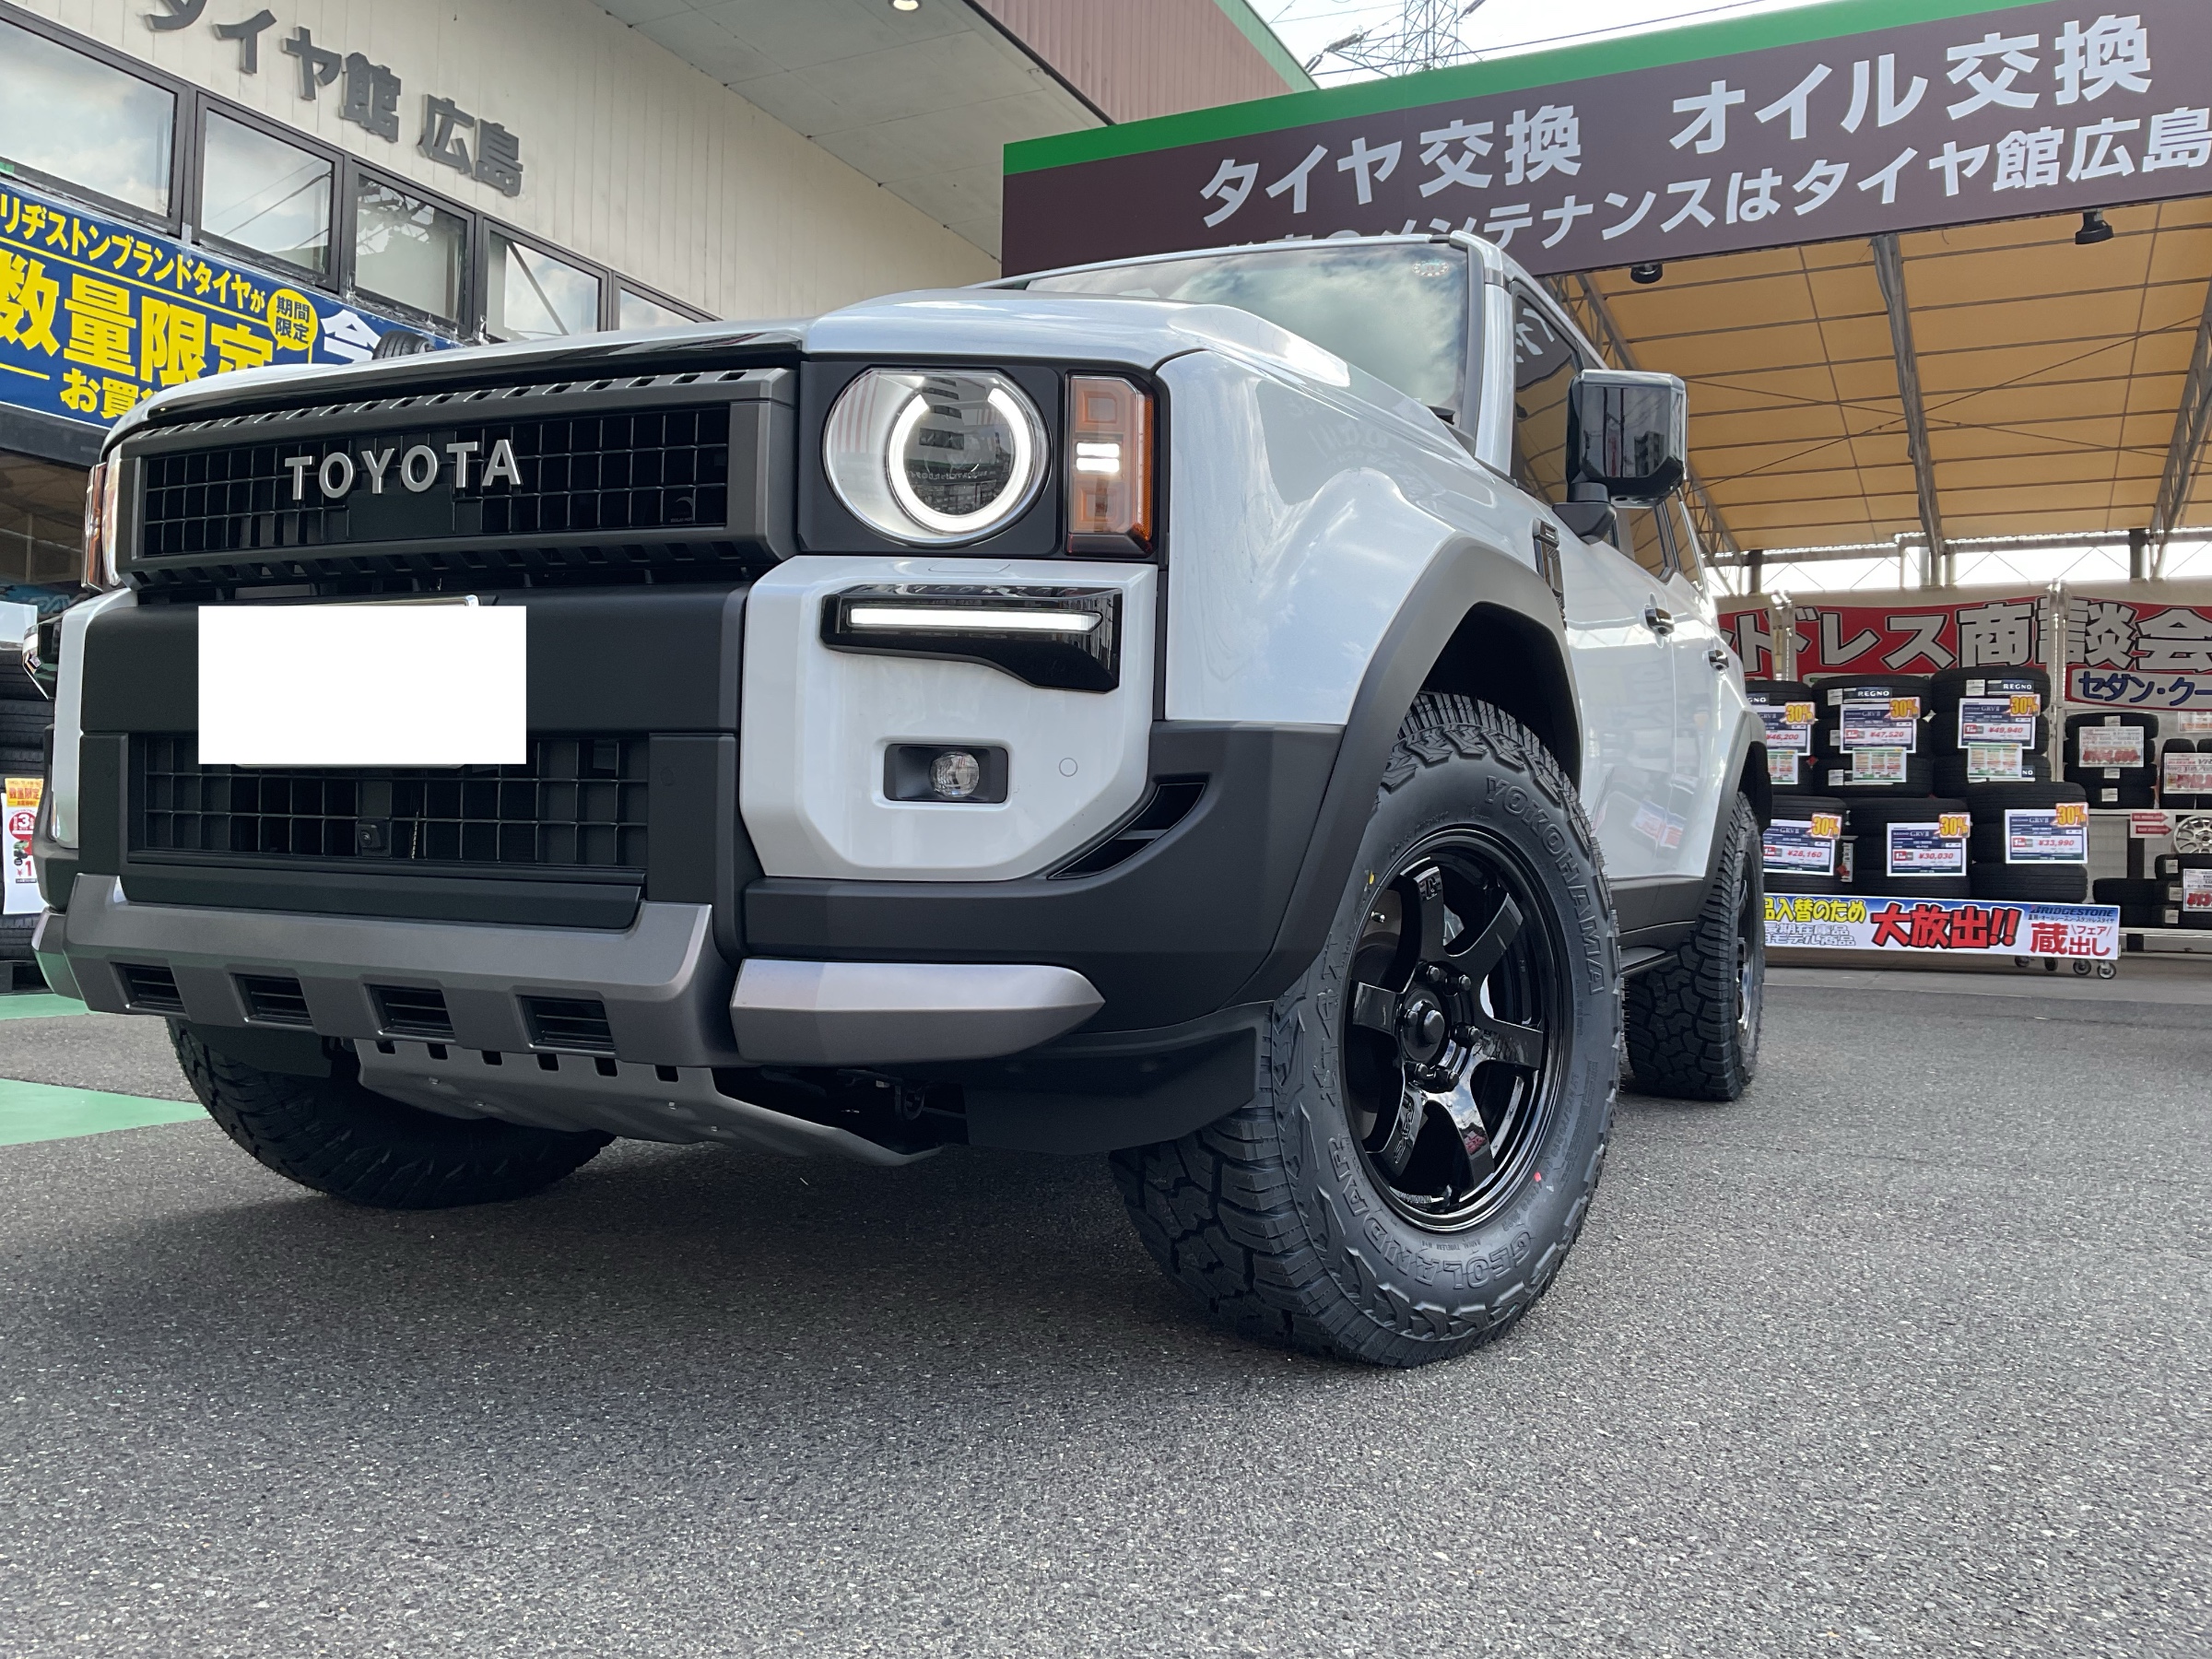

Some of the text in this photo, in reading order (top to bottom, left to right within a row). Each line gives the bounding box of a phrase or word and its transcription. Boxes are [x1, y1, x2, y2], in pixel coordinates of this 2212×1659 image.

[144, 0, 524, 196] タイヤ館 広島
[1200, 14, 2153, 229] タイヤ交換 オイル交換
[1, 193, 265, 313] リヂストンブランドタイヤが
[0, 249, 274, 387] 数量限定
[276, 295, 311, 324] 期間
[275, 316, 310, 345] 限定
[59, 369, 157, 419] お買
[284, 438, 524, 502] TOYOTA
[1721, 605, 2212, 673] ドレス商談会
[1785, 704, 1813, 723] 30%
[1890, 699, 1918, 718] 30%
[2010, 697, 2039, 714] 30%
[1812, 817, 1839, 836] 30%
[1940, 817, 1969, 836] 30%
[2057, 806, 2087, 825] 30%
[1485, 773, 1606, 996] YOKOHAMA
[1870, 902, 2022, 949] 大放出!!
[2031, 906, 2114, 917] BRIDGESTONE
[2030, 923, 2111, 957] 蔵出し
[1328, 1136, 1534, 1290] GEOLANDAR
